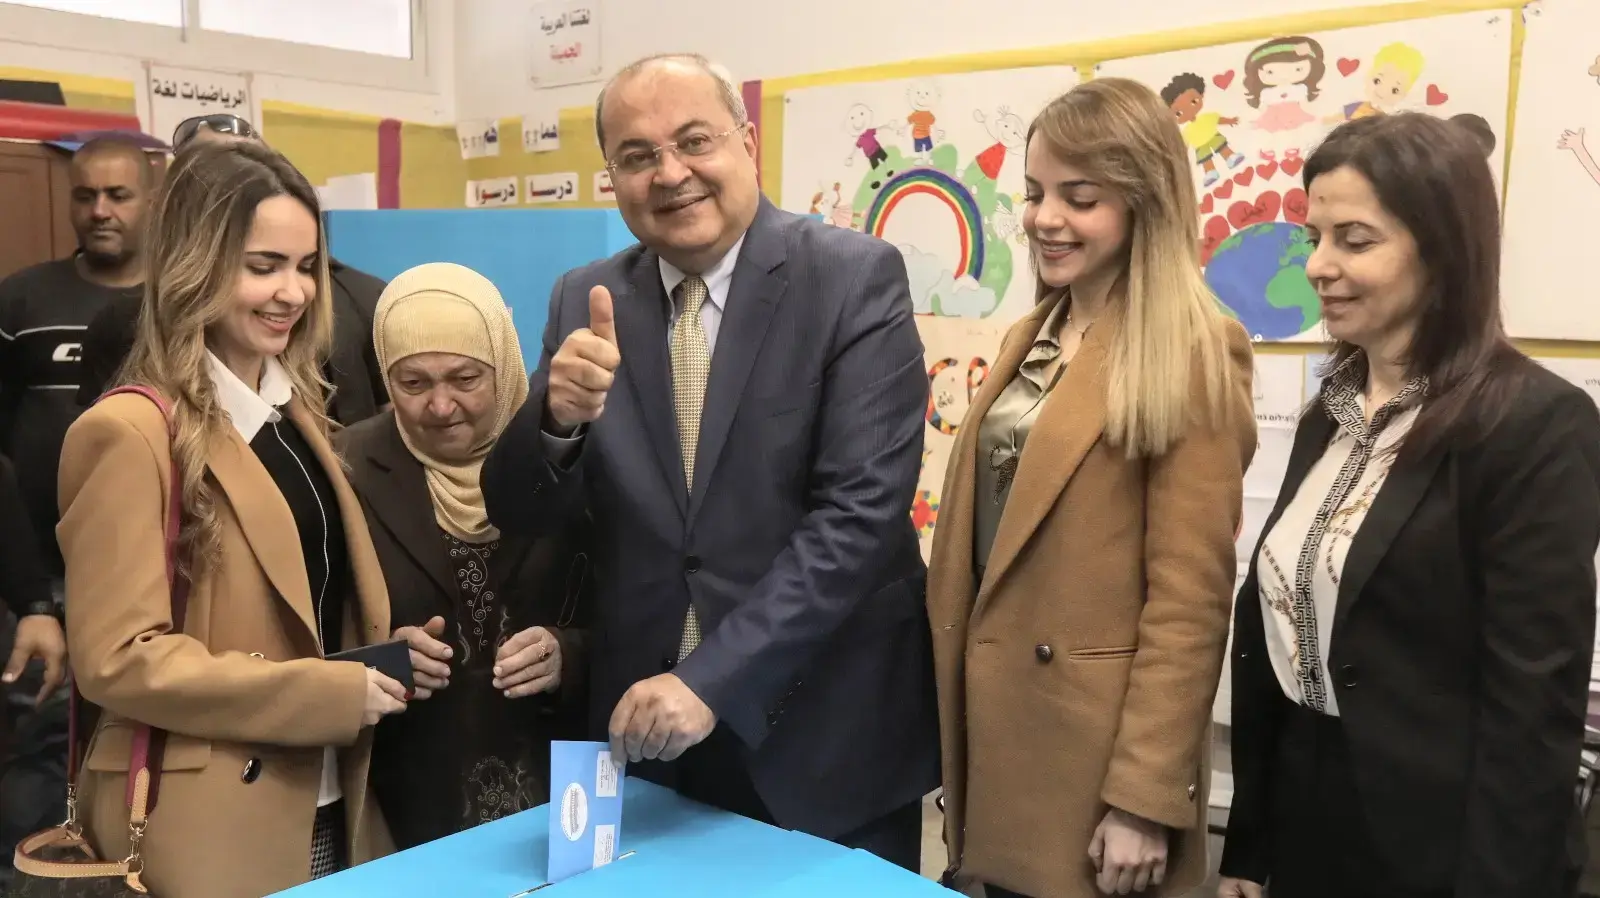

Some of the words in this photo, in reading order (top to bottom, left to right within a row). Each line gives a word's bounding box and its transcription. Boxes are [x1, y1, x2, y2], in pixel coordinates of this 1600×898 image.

[540, 12, 567, 36] العربية
[152, 79, 177, 98] لغة
[182, 82, 246, 108] الرياضيات
[475, 184, 515, 204] درسوا
[530, 180, 573, 200] درسا
